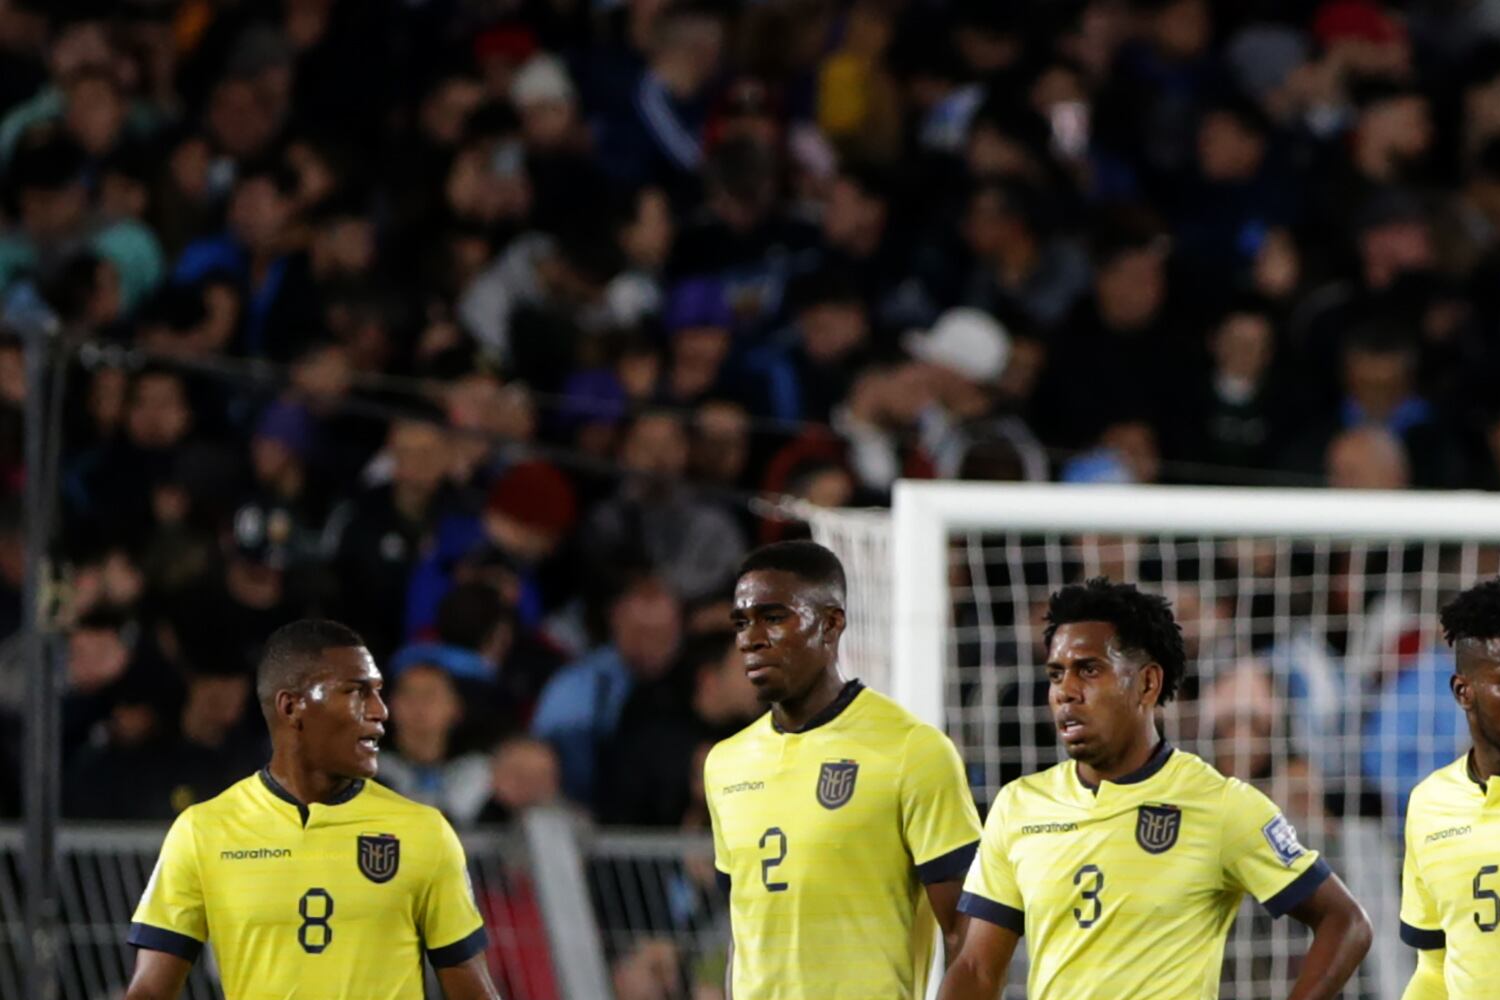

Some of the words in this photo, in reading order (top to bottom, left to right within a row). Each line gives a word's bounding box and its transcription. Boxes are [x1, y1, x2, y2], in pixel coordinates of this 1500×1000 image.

[220, 848, 292, 860] marathon
[758, 826, 789, 893] 2
[1022, 822, 1079, 834] marathon
[298, 887, 334, 954] 8
[1073, 864, 1104, 929] 3
